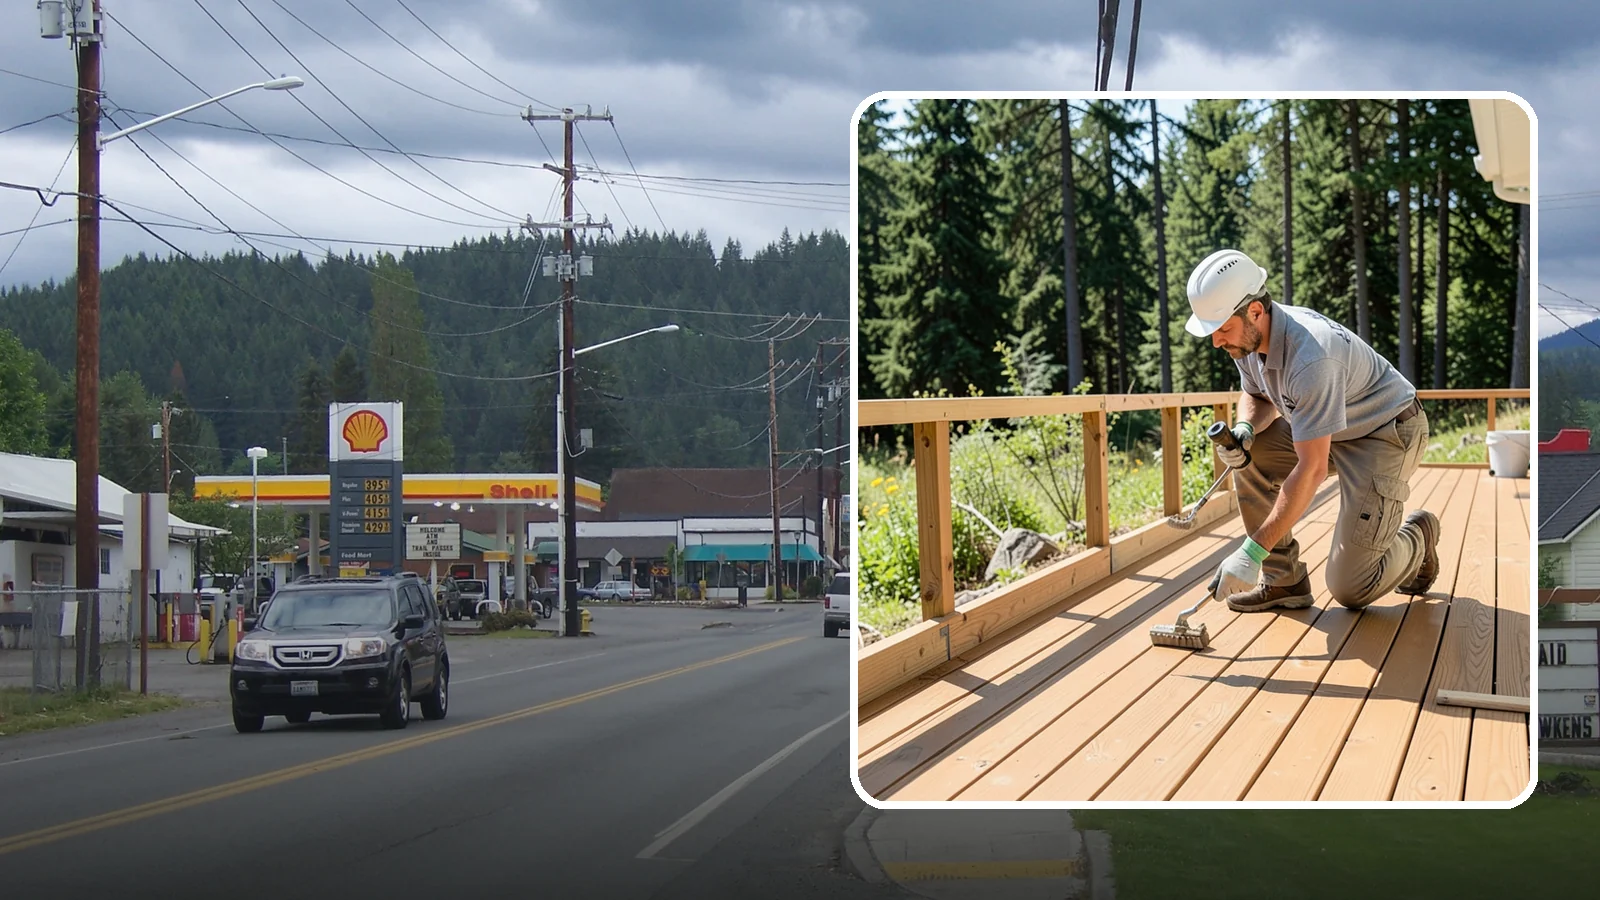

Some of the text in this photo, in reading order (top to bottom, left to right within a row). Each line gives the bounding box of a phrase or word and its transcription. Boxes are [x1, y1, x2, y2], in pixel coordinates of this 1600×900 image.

[366, 480, 384, 490] 395
[490, 484, 547, 499] Shell
[365, 494, 384, 504] 405
[365, 508, 384, 518] 415
[365, 522, 384, 533] 429
[1538, 642, 1566, 666] AID
[1538, 715, 1592, 738] WKENS
